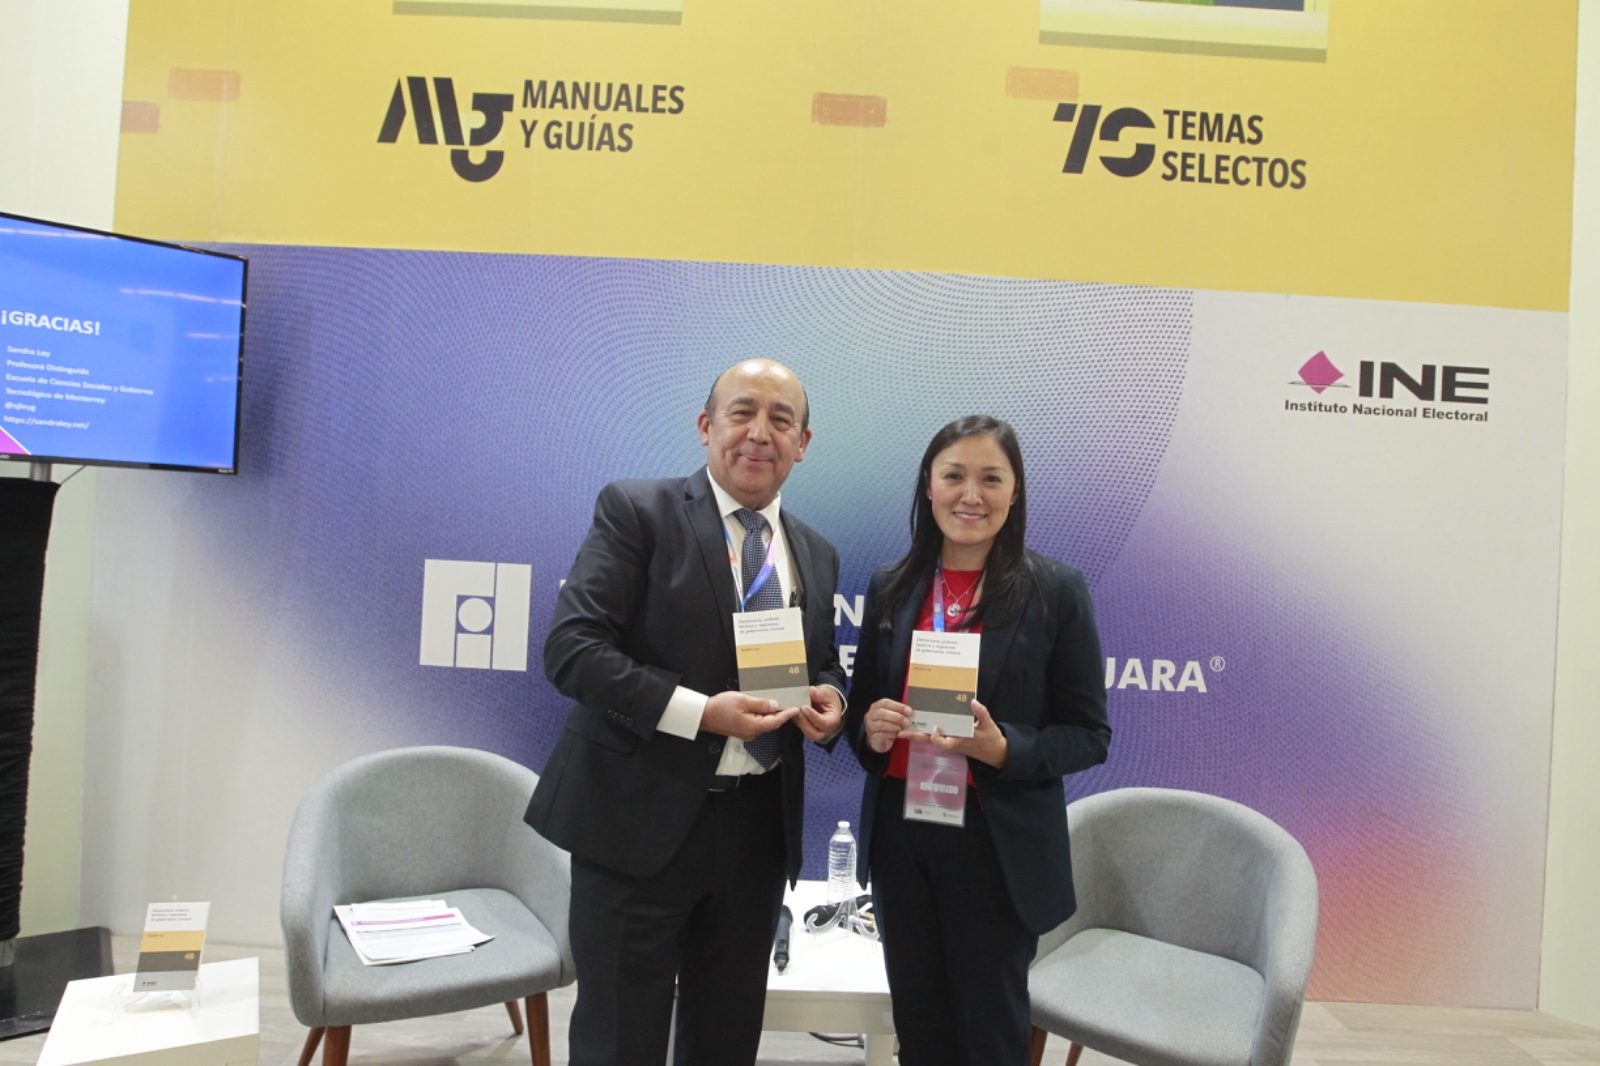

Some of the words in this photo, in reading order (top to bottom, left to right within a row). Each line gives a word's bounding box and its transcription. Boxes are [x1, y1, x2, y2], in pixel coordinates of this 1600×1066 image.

[522, 79, 686, 114] MANUALES
[520, 119, 538, 149] Y
[543, 114, 634, 152] GUÍAS
[1163, 108, 1264, 145] TEMAS
[1162, 150, 1307, 190] SELECTOS
[2, 310, 100, 336] ¡GRACIAS!
[7, 346, 35, 354] Sandra
[37, 350, 51, 358] Ley
[6, 360, 44, 370] Profesora
[47, 364, 89, 375] Distinguida
[6, 374, 36, 383] Escuela
[50, 378, 81, 388] Ciencias
[82, 381, 112, 391] Sociales
[120, 385, 154, 395] Gobierno
[1359, 360, 1490, 404] INE
[65, 393, 106, 404] Monterrey
[1284, 400, 1348, 414] Instituto
[1352, 404, 1417, 418] Nacional
[1422, 408, 1489, 422] Electoral
[788, 666, 800, 674] 48
[956, 694, 967, 702] 48
